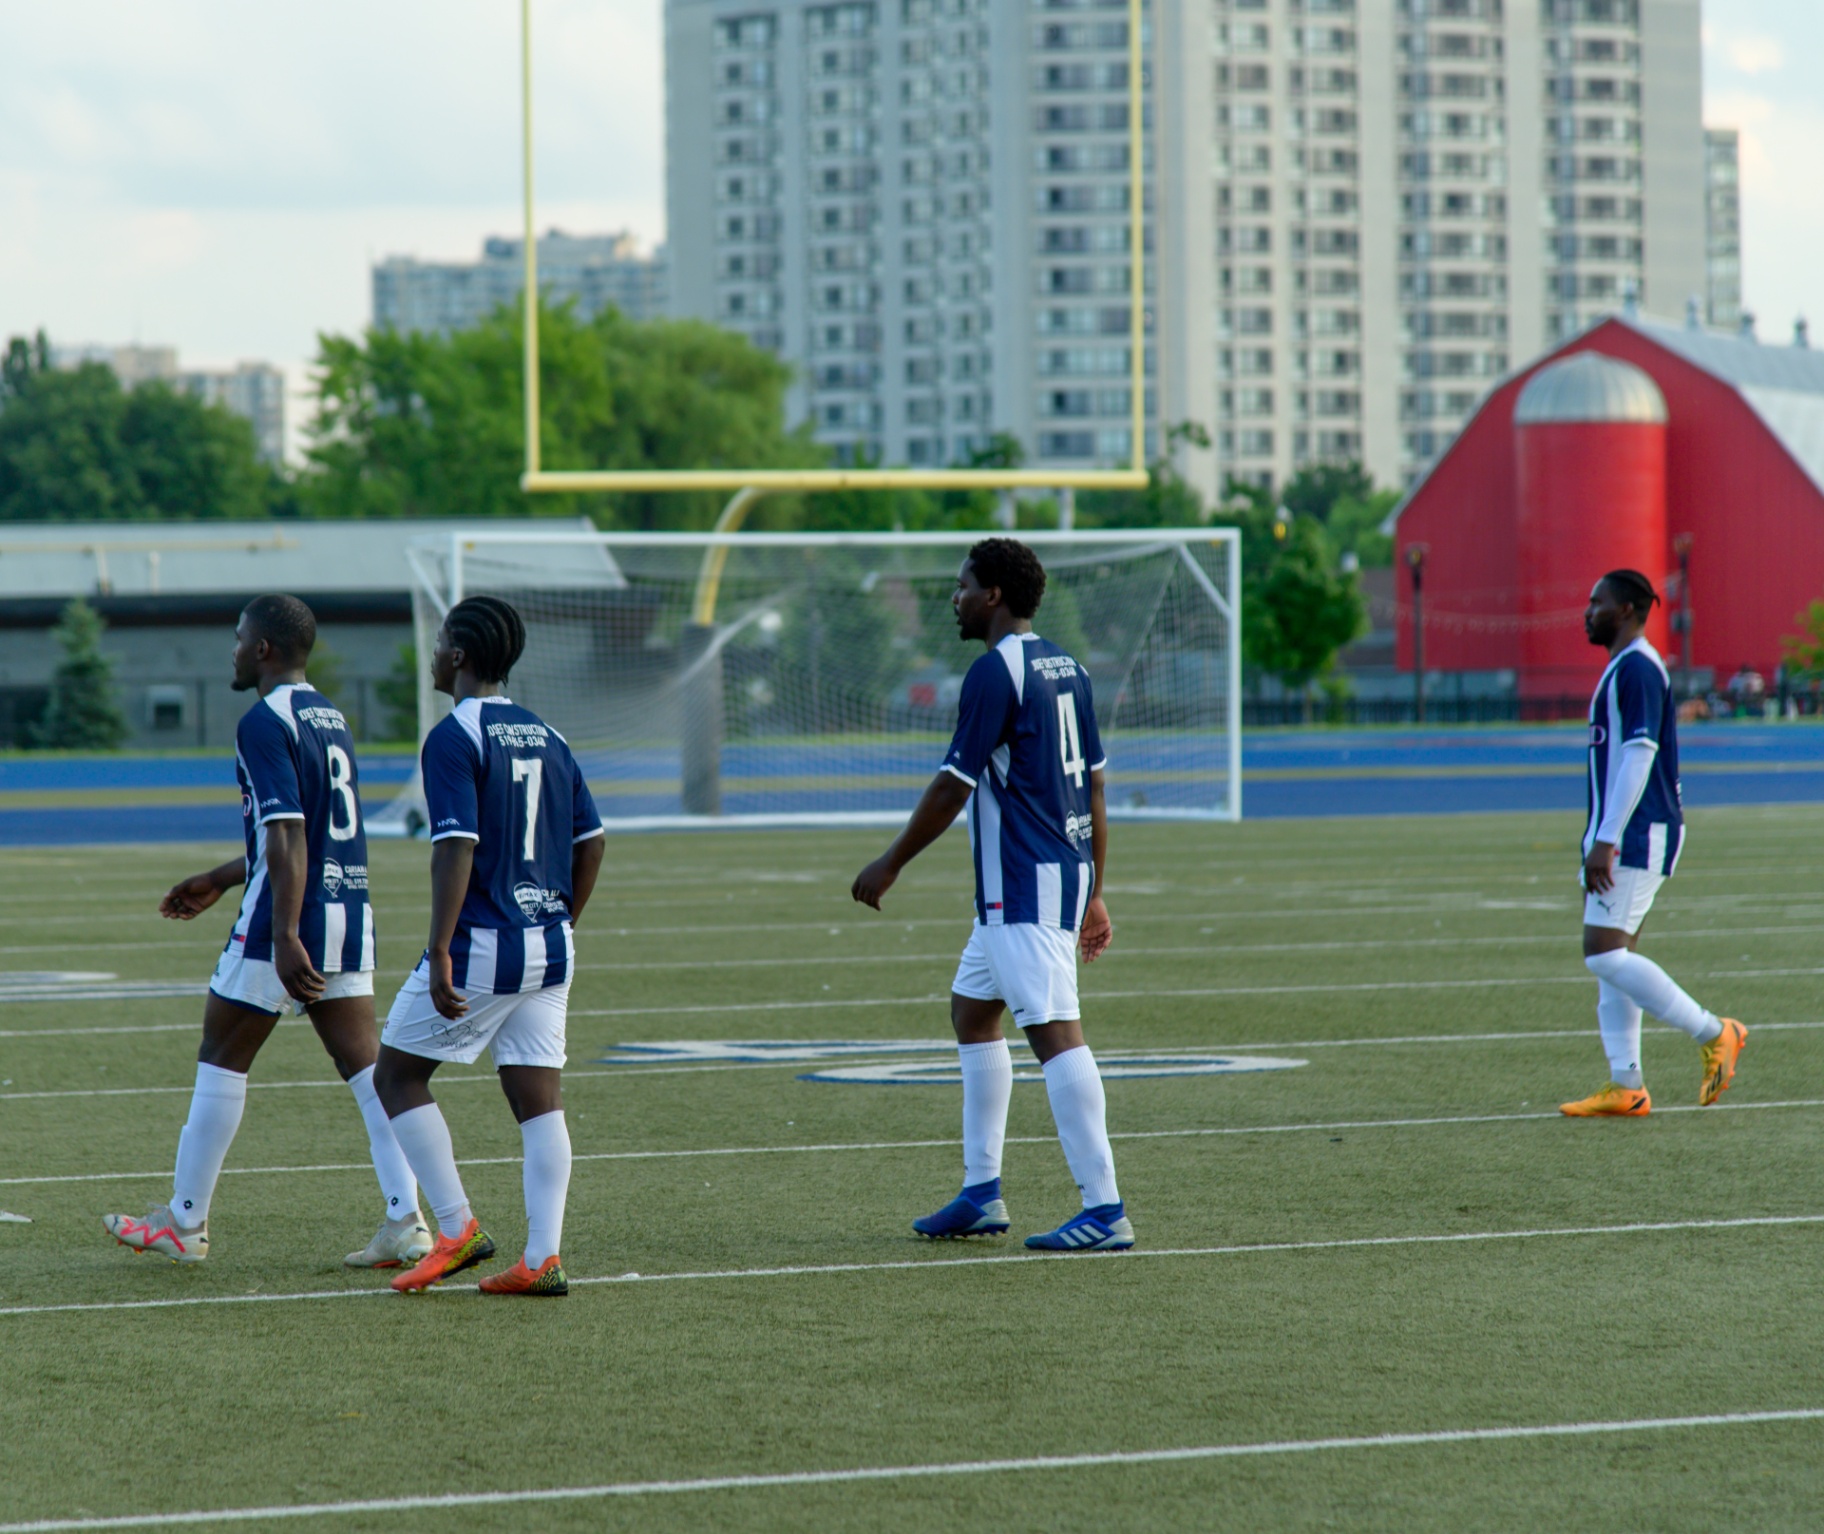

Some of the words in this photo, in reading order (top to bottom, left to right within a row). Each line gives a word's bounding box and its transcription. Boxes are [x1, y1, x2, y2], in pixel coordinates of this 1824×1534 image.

[1057, 692, 1086, 788] 4
[327, 744, 358, 841] 8
[512, 758, 543, 861] 7
